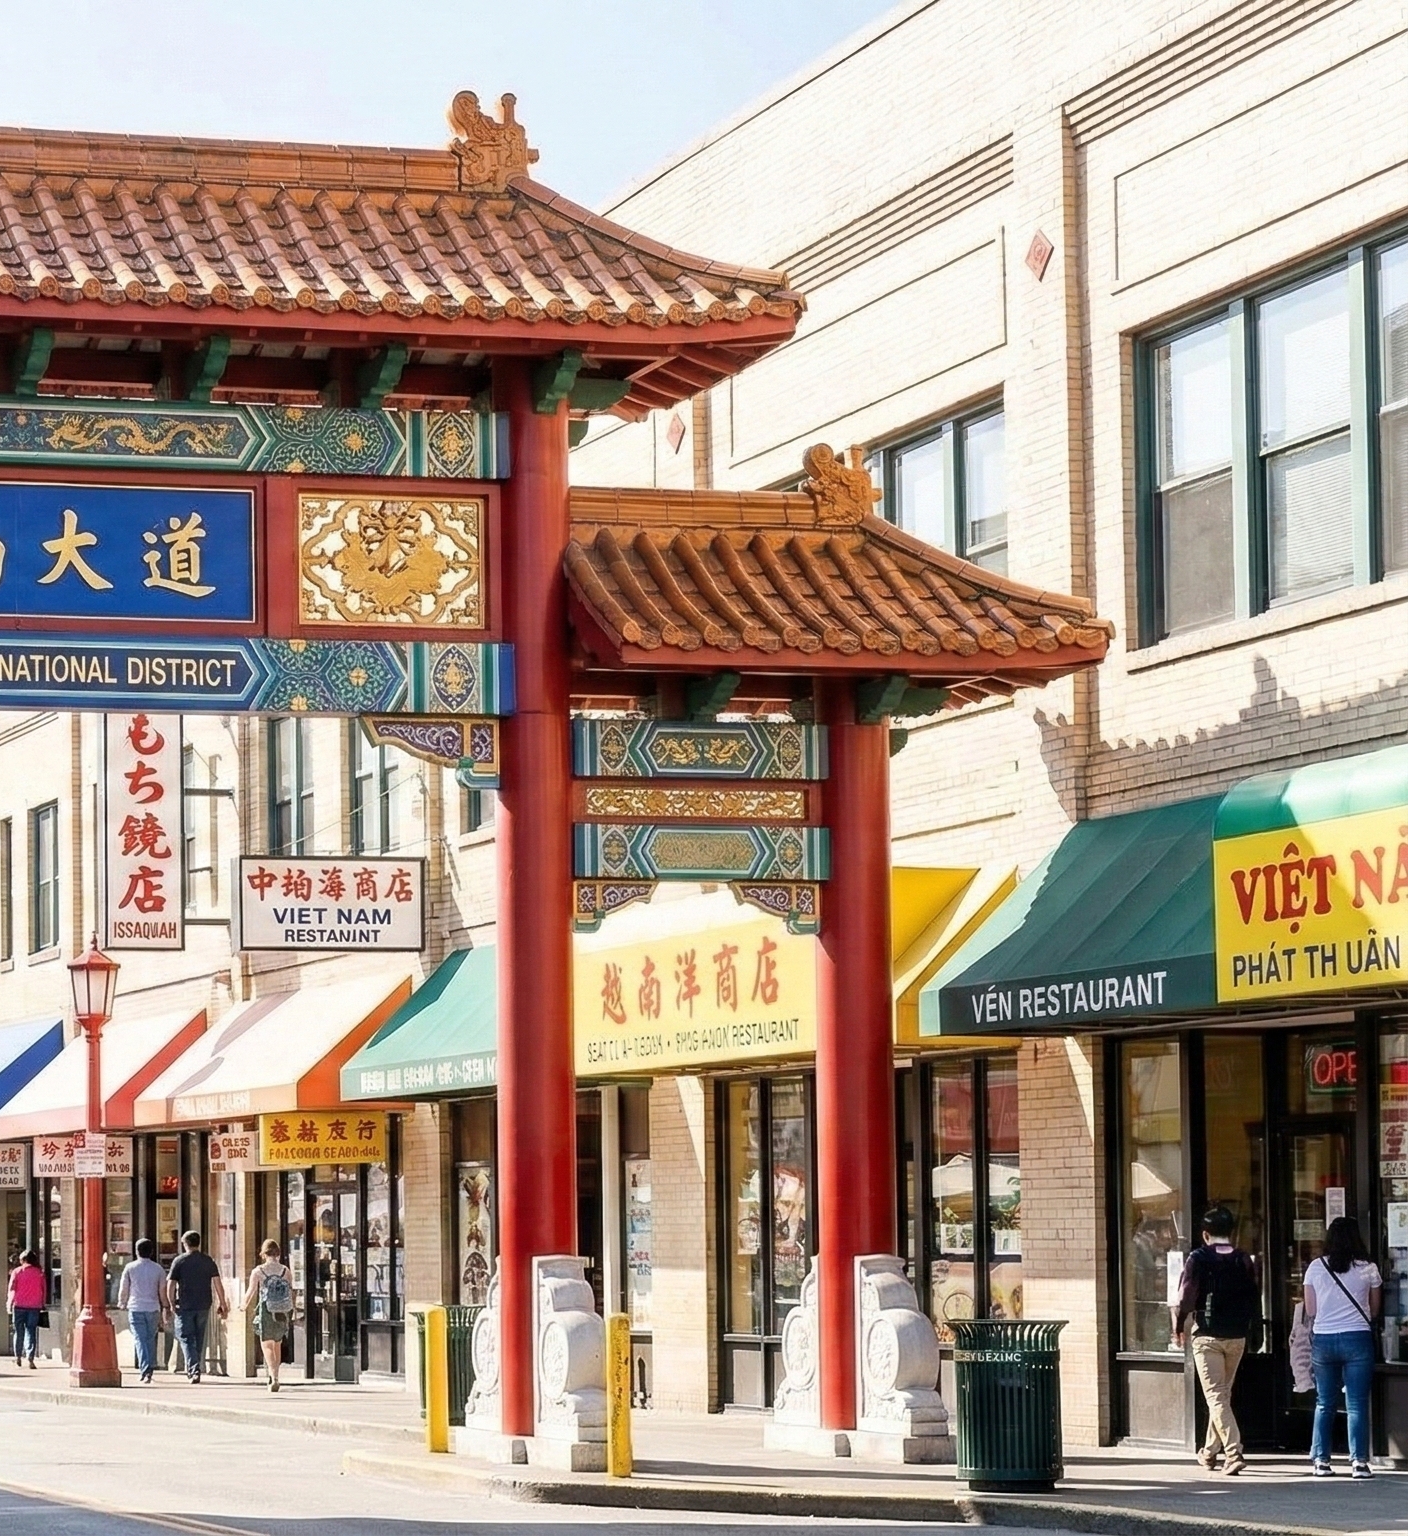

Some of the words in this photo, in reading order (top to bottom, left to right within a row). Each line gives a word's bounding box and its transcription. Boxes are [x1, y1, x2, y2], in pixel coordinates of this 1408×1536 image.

[127, 656, 237, 688] DISTRICT
[273, 908, 327, 924] VIET
[337, 908, 392, 925] NAM
[1233, 940, 1297, 988] PHÁT
[1303, 943, 1338, 979] TH
[971, 984, 1012, 1024] VÉN
[1019, 971, 1168, 1019] RESTAURANT
[732, 1018, 800, 1048] RESTAURANT
